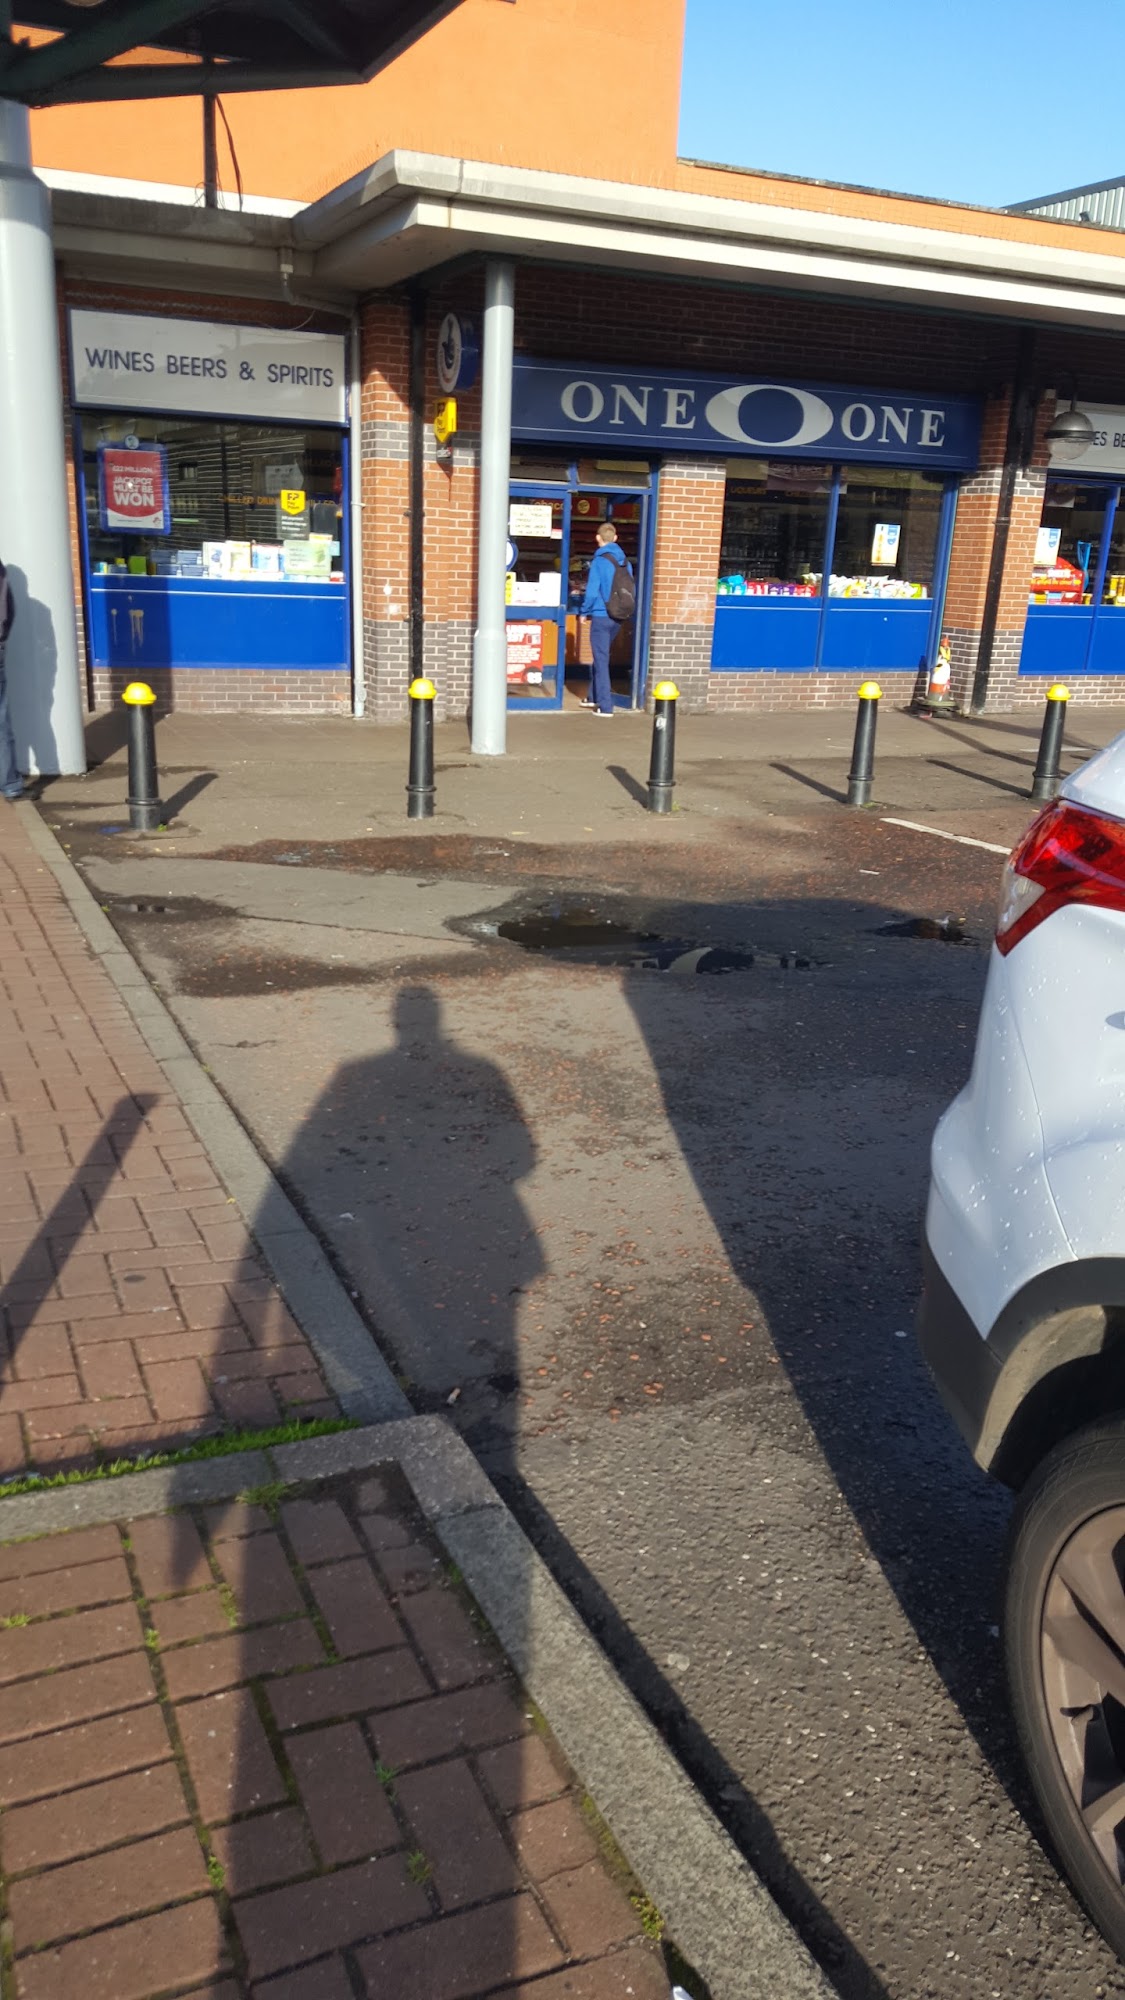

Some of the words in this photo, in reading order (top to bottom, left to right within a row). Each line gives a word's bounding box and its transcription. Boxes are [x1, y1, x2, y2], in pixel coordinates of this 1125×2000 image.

[85, 347, 154, 372] WINES
[167, 354, 227, 379] BEERS
[239, 361, 255, 381] &
[267, 363, 334, 387] SPIRITS
[560, 380, 696, 429] ONE
[840, 402, 945, 447] ONE
[113, 476, 154, 484] JACKPOT
[113, 484, 141, 493] MUST
[141, 485, 154, 493] BE
[113, 492, 155, 507] WON
